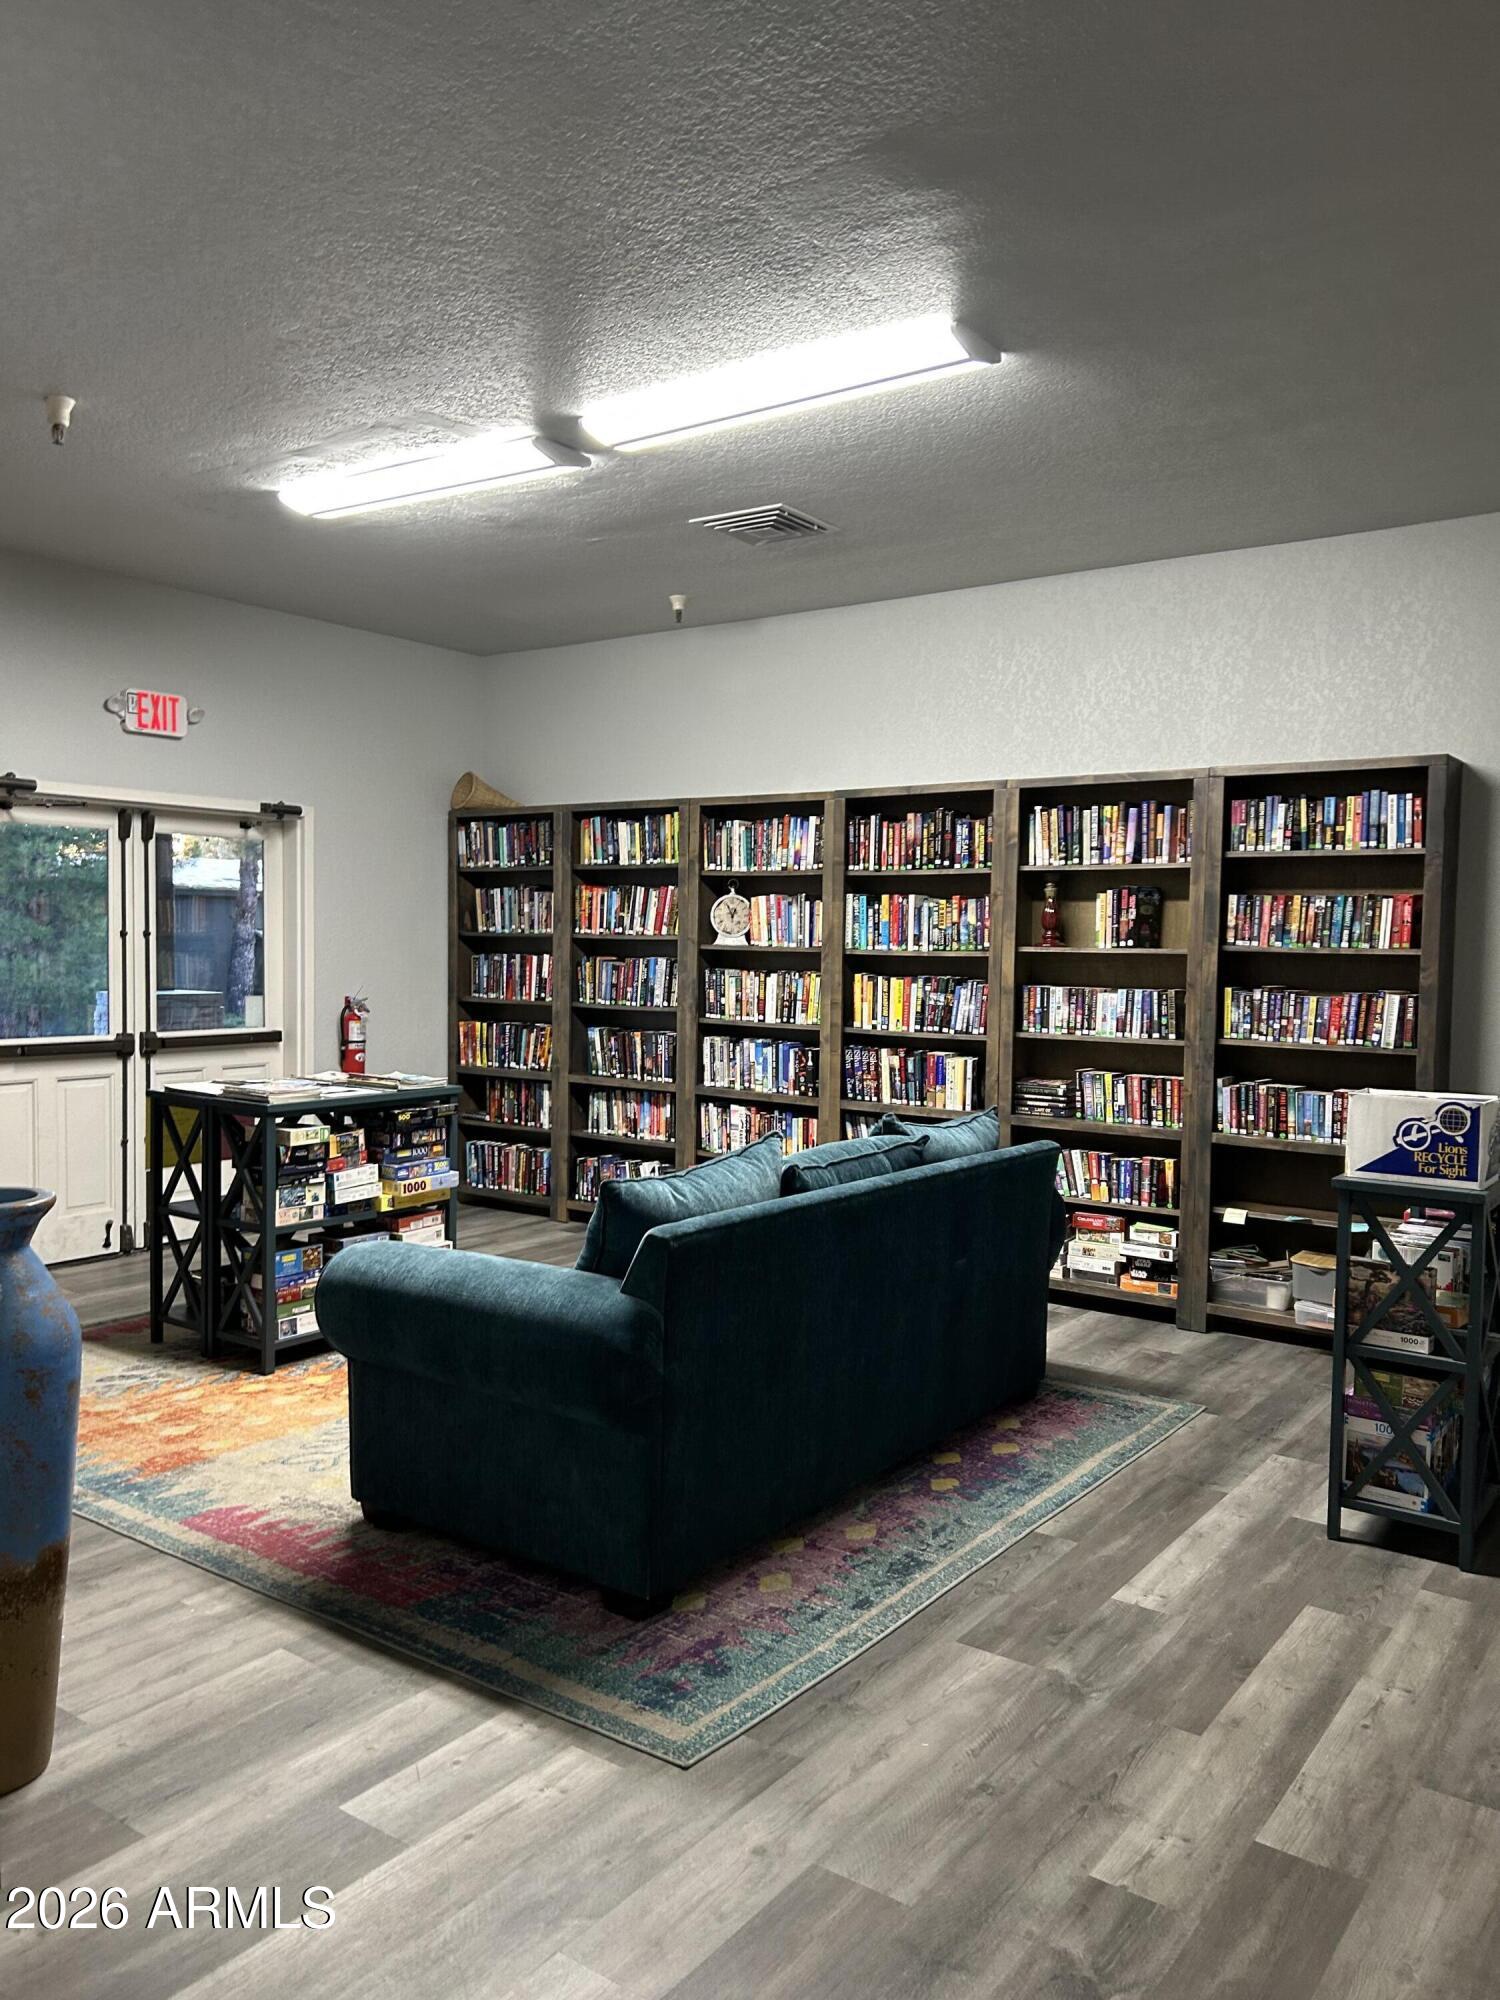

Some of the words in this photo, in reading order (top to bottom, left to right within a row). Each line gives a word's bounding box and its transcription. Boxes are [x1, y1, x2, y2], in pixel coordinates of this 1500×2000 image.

[137, 691, 180, 732] EXIT
[961, 839, 969, 857] SAIL
[412, 1146, 428, 1156] 1000
[1438, 1142, 1468, 1155] Lions
[1414, 1151, 1468, 1165] RECYCLE
[1418, 1163, 1437, 1174] For
[1439, 1164, 1468, 1179] Sight
[402, 1180, 427, 1194] 1000
[1400, 1336, 1419, 1345] 1000
[1375, 1423, 1393, 1434] 100
